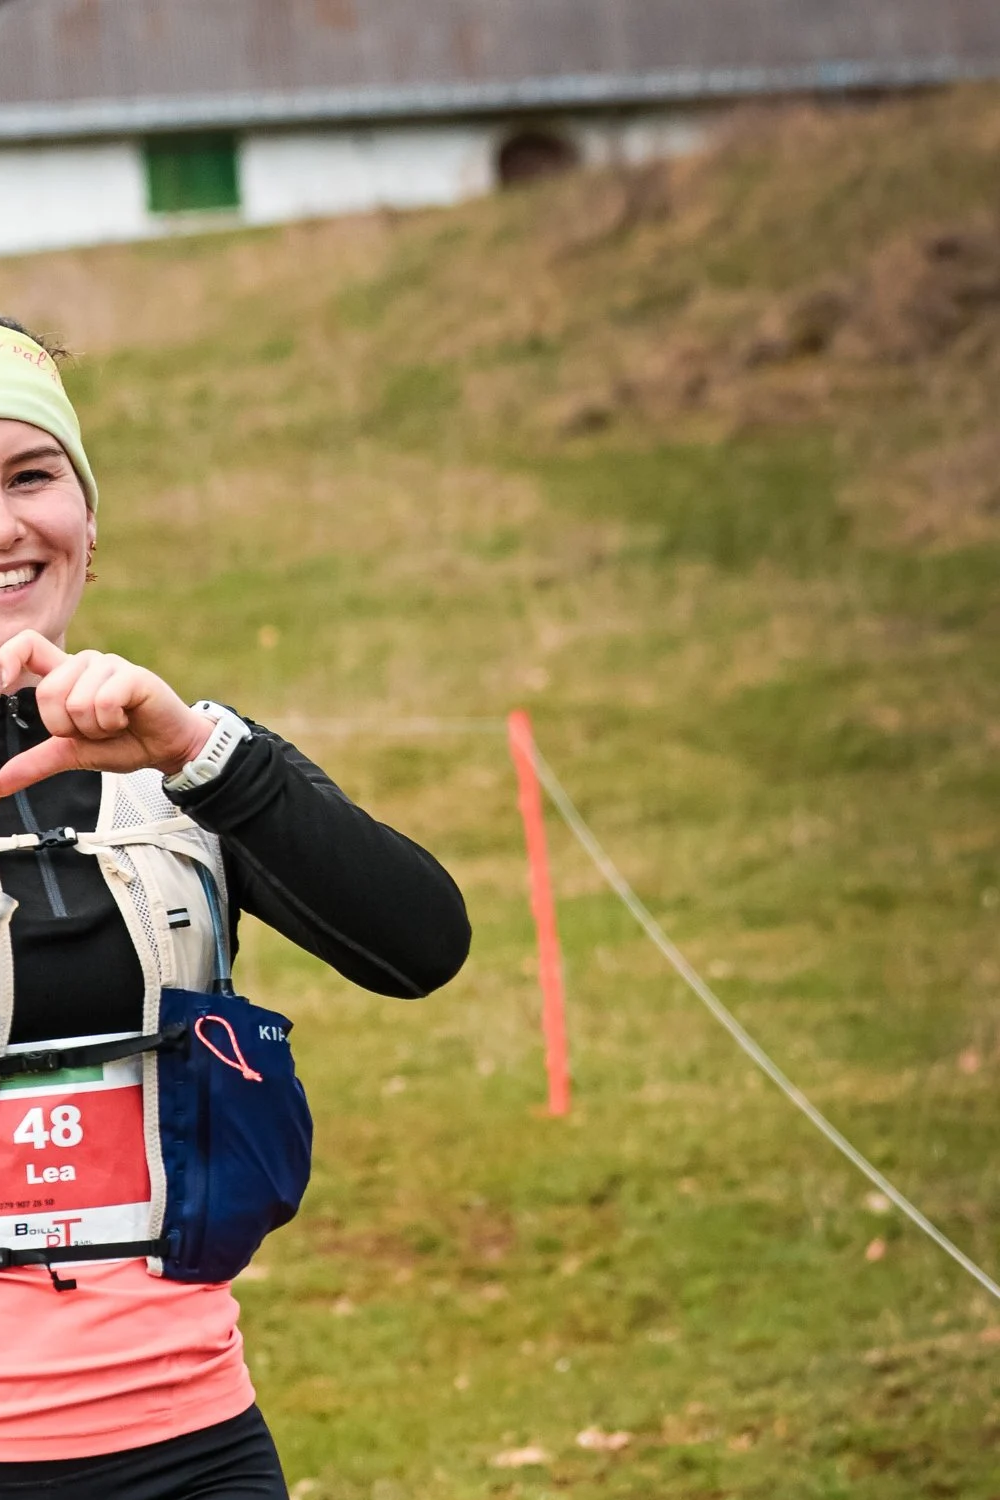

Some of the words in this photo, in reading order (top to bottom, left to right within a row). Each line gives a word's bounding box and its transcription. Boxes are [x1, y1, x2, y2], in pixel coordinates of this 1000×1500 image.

[12, 345, 48, 371] val
[13, 1104, 84, 1150] 48
[25, 1163, 77, 1185] Lea
